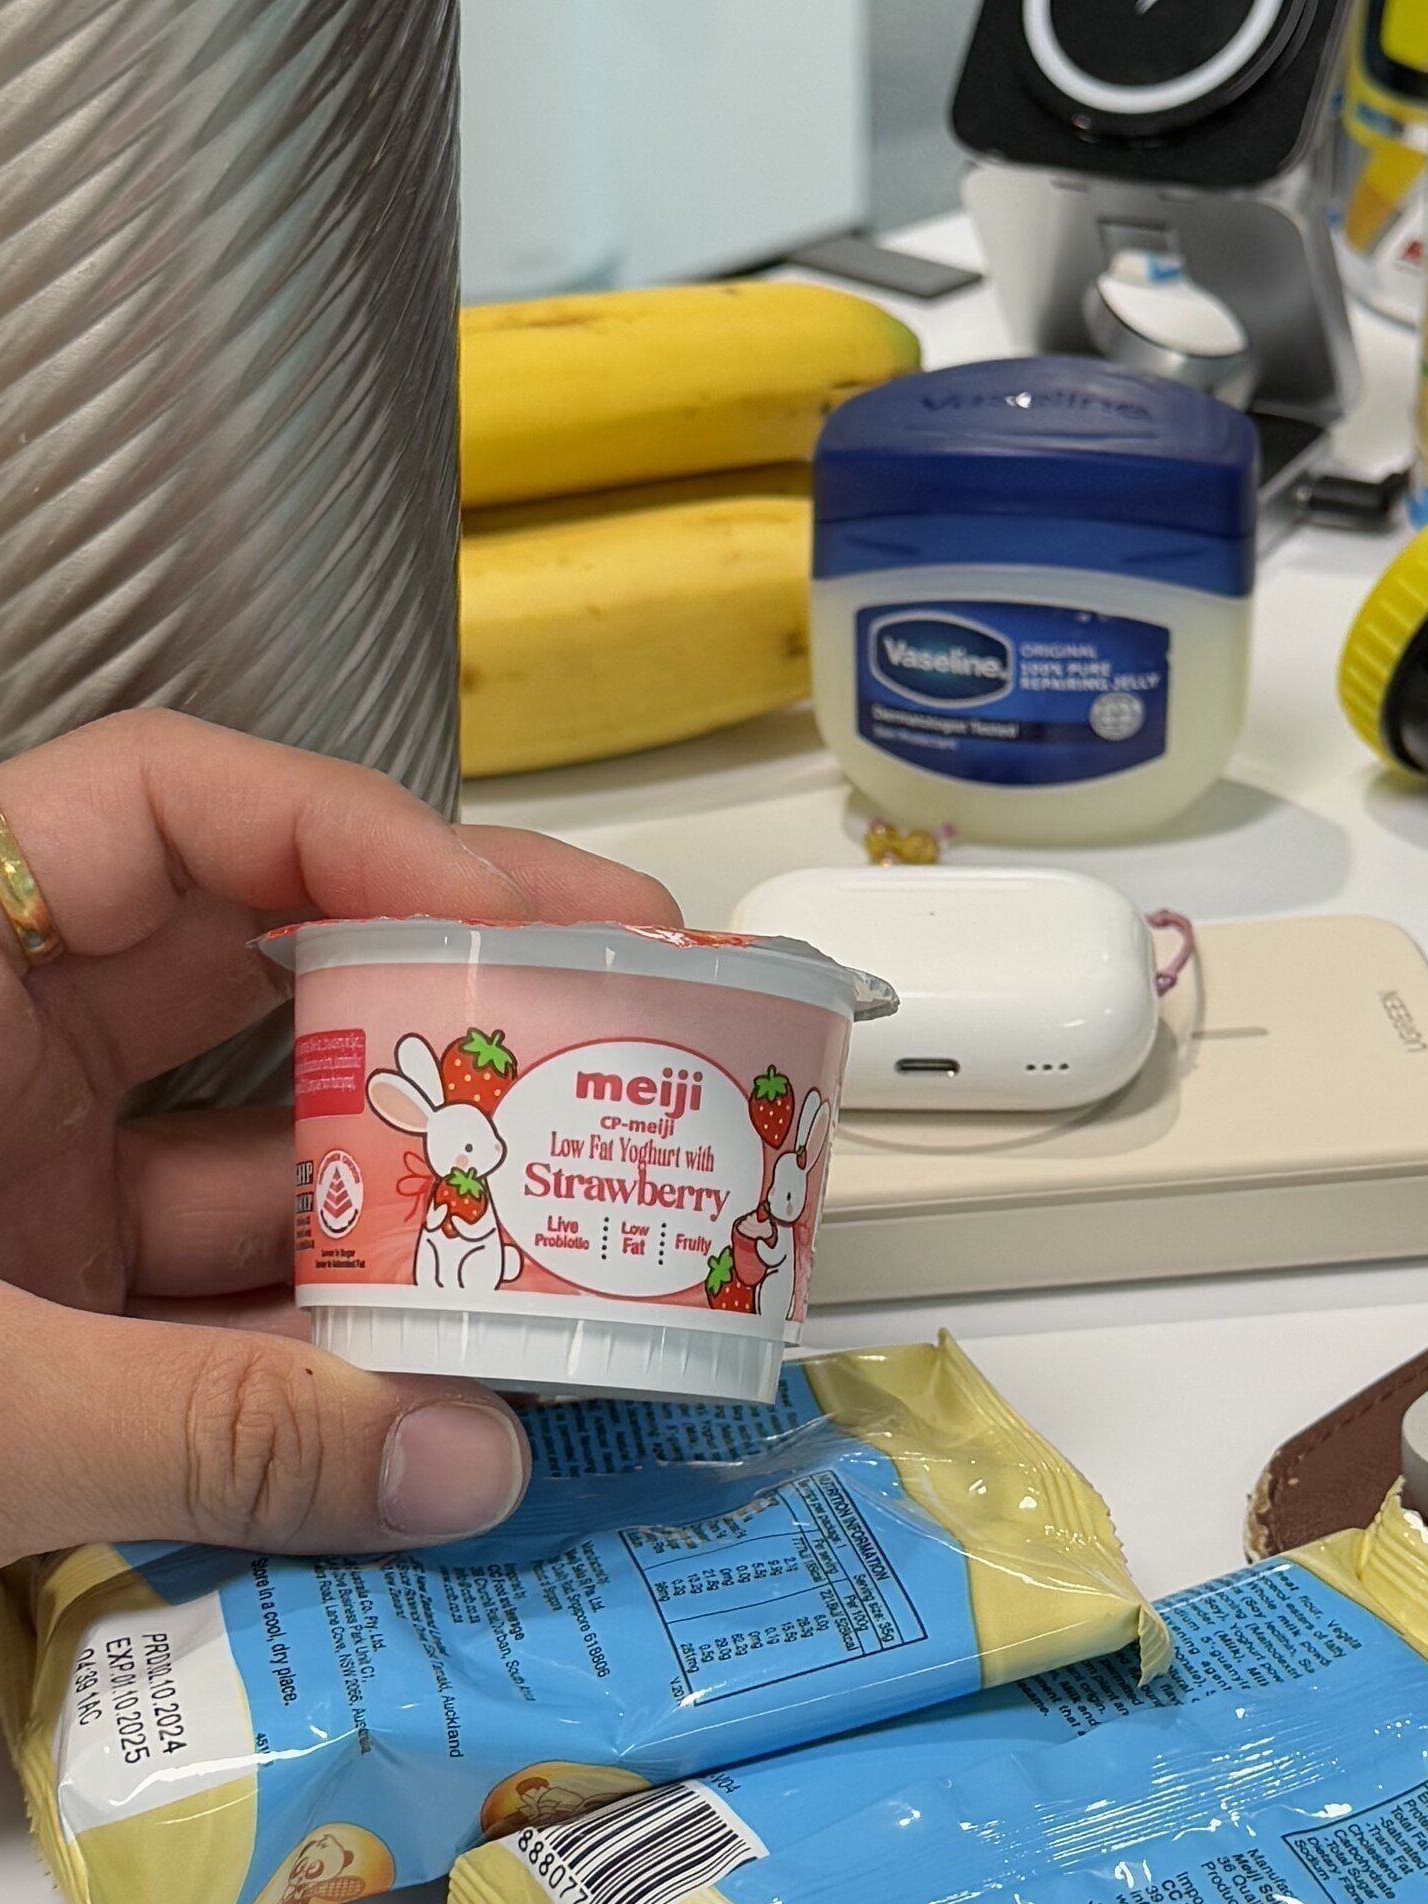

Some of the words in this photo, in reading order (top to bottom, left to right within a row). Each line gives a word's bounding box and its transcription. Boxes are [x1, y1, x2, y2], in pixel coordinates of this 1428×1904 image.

[882, 635, 1004, 680] Vaseline
[1019, 644, 1097, 660] ORIGINAL
[1067, 662, 1111, 678] PURE
[1111, 672, 1161, 692] JELLY
[576, 1067, 703, 1119] meiji
[600, 1115, 675, 1139] CP-meiji
[550, 1131, 584, 1158] Low
[589, 1134, 614, 1161] Fat
[619, 1137, 681, 1171] Yoghurt
[685, 1146, 714, 1172] with
[524, 1162, 731, 1222] Strawberry
[547, 1215, 579, 1233] Live
[622, 1221, 650, 1236] Low
[622, 1236, 646, 1255] Fat
[675, 1233, 712, 1256] Fruity
[262, 1611, 287, 1642] cool,
[1229, 1622, 1266, 1662] Yoghurt
[269, 1643, 290, 1664] dry
[583, 1632, 611, 1678] 618806
[1213, 1630, 1246, 1664] (Milk),
[106, 1636, 151, 1764] EXP.01.10.2025
[142, 1633, 188, 1754] PRD.02.10.2024
[272, 1666, 298, 1706] place.
[1080, 1682, 1106, 1716] origin.
[78, 1692, 103, 1726] 1AC
[441, 1695, 464, 1758] Auckland
[1390, 1804, 1418, 1833] Total
[1216, 1856, 1237, 1873] 36
[1294, 1838, 1330, 1882] Sodium
[1306, 1836, 1342, 1874] Dietary
[1333, 1828, 1396, 1900] Carbohydrate
[1347, 1823, 1403, 1883] Cholesterol
[1366, 1822, 1396, 1856] -Trans
[1392, 1854, 1414, 1876] Fat
[1232, 1853, 1264, 1882] Meiji
[1347, 1867, 1380, 1900] Sugar
[1145, 1884, 1164, 1903] 39
[1161, 1879, 1184, 1902] CC
